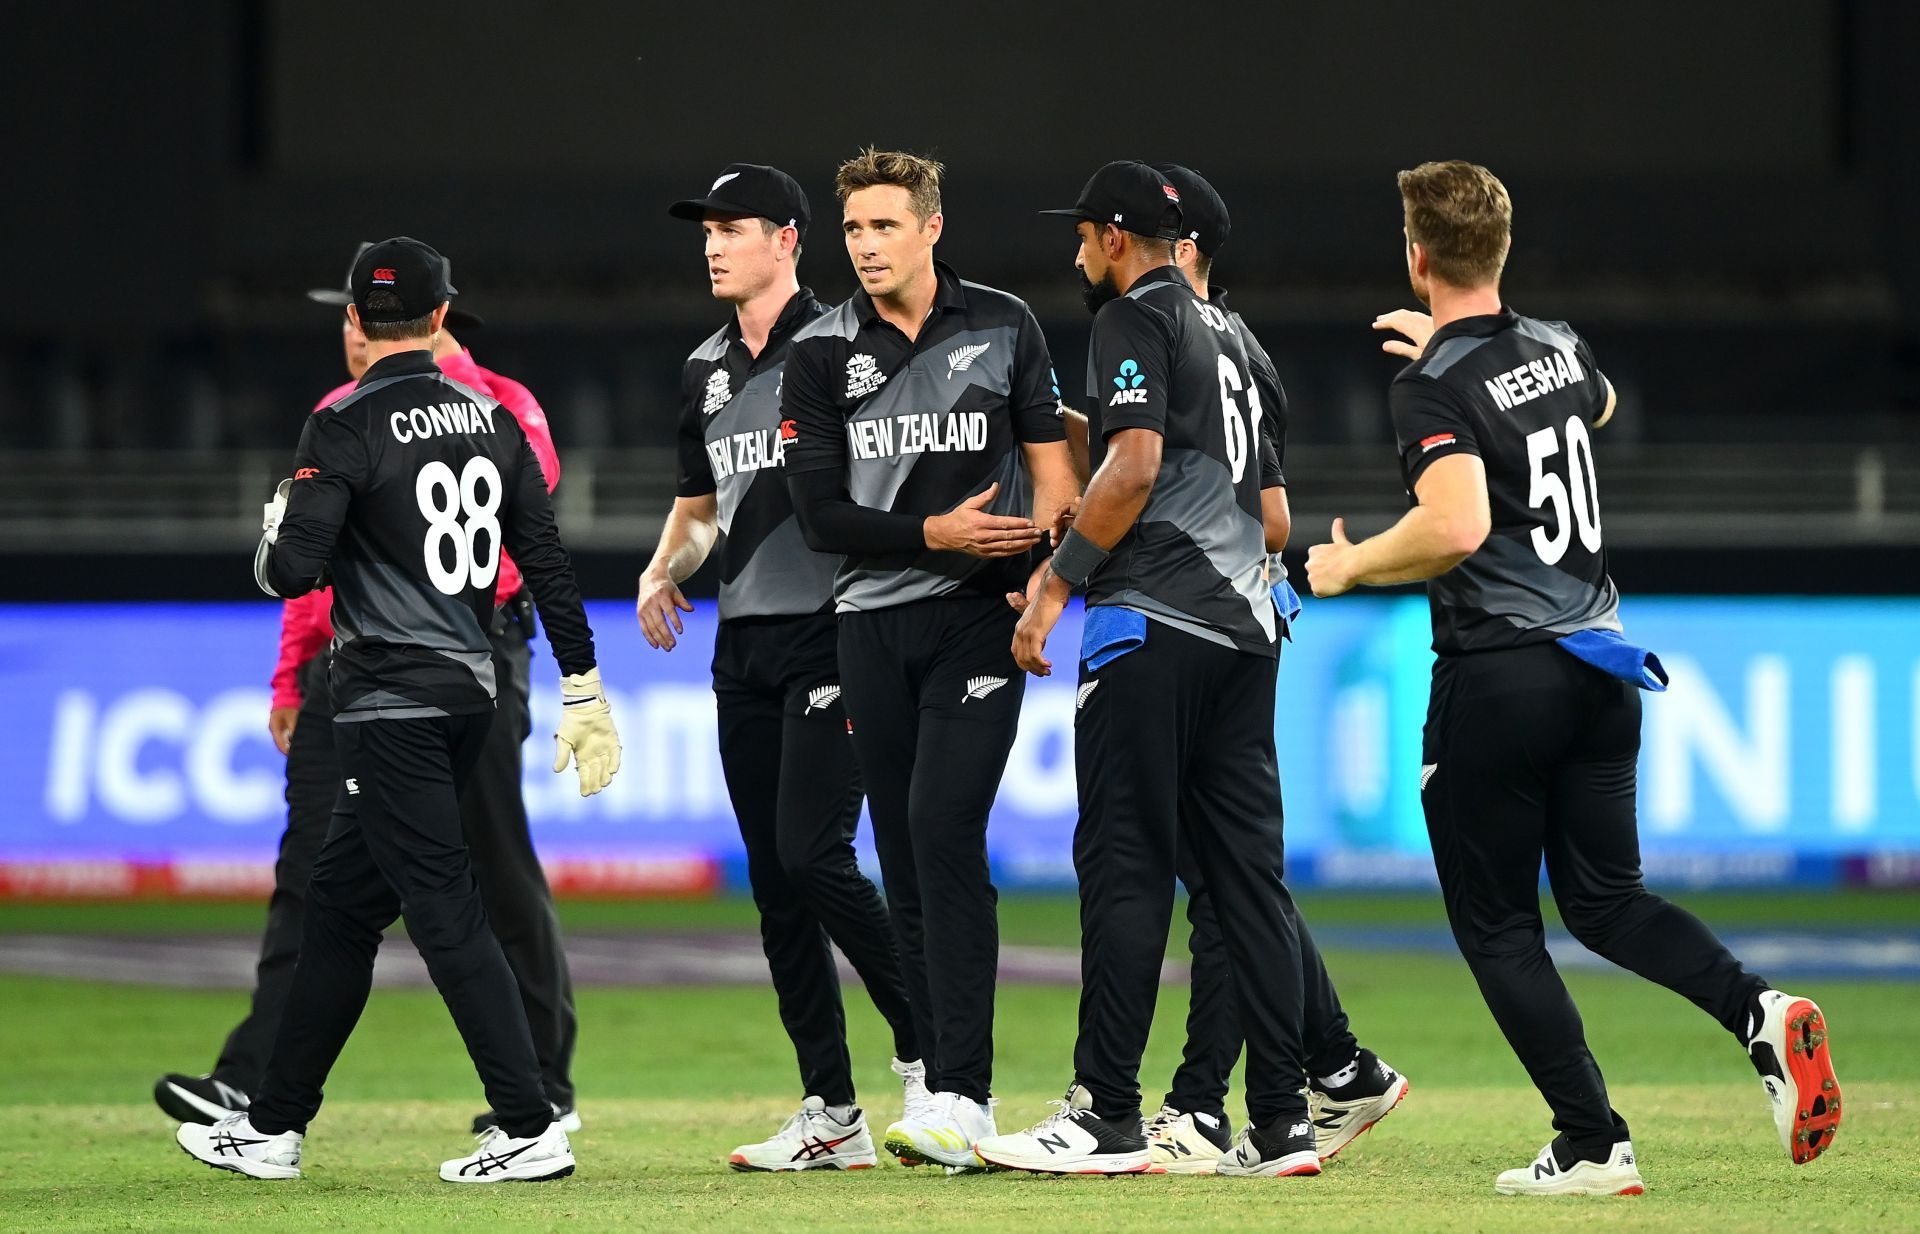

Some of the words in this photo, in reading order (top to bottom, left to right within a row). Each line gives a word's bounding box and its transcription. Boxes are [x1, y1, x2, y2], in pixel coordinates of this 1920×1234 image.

[845, 384, 871, 398] WORLD
[872, 375, 887, 386] CUP
[1108, 388, 1148, 407] ANZ
[1485, 350, 1585, 412] NEESHAM
[390, 402, 497, 444] CONWAY
[848, 418, 893, 460] NEW
[898, 412, 988, 454] ZEALAND
[734, 428, 785, 472] ZEALA
[1526, 415, 1602, 566] 50
[415, 455, 503, 596] 88
[46, 687, 286, 824] ICC
